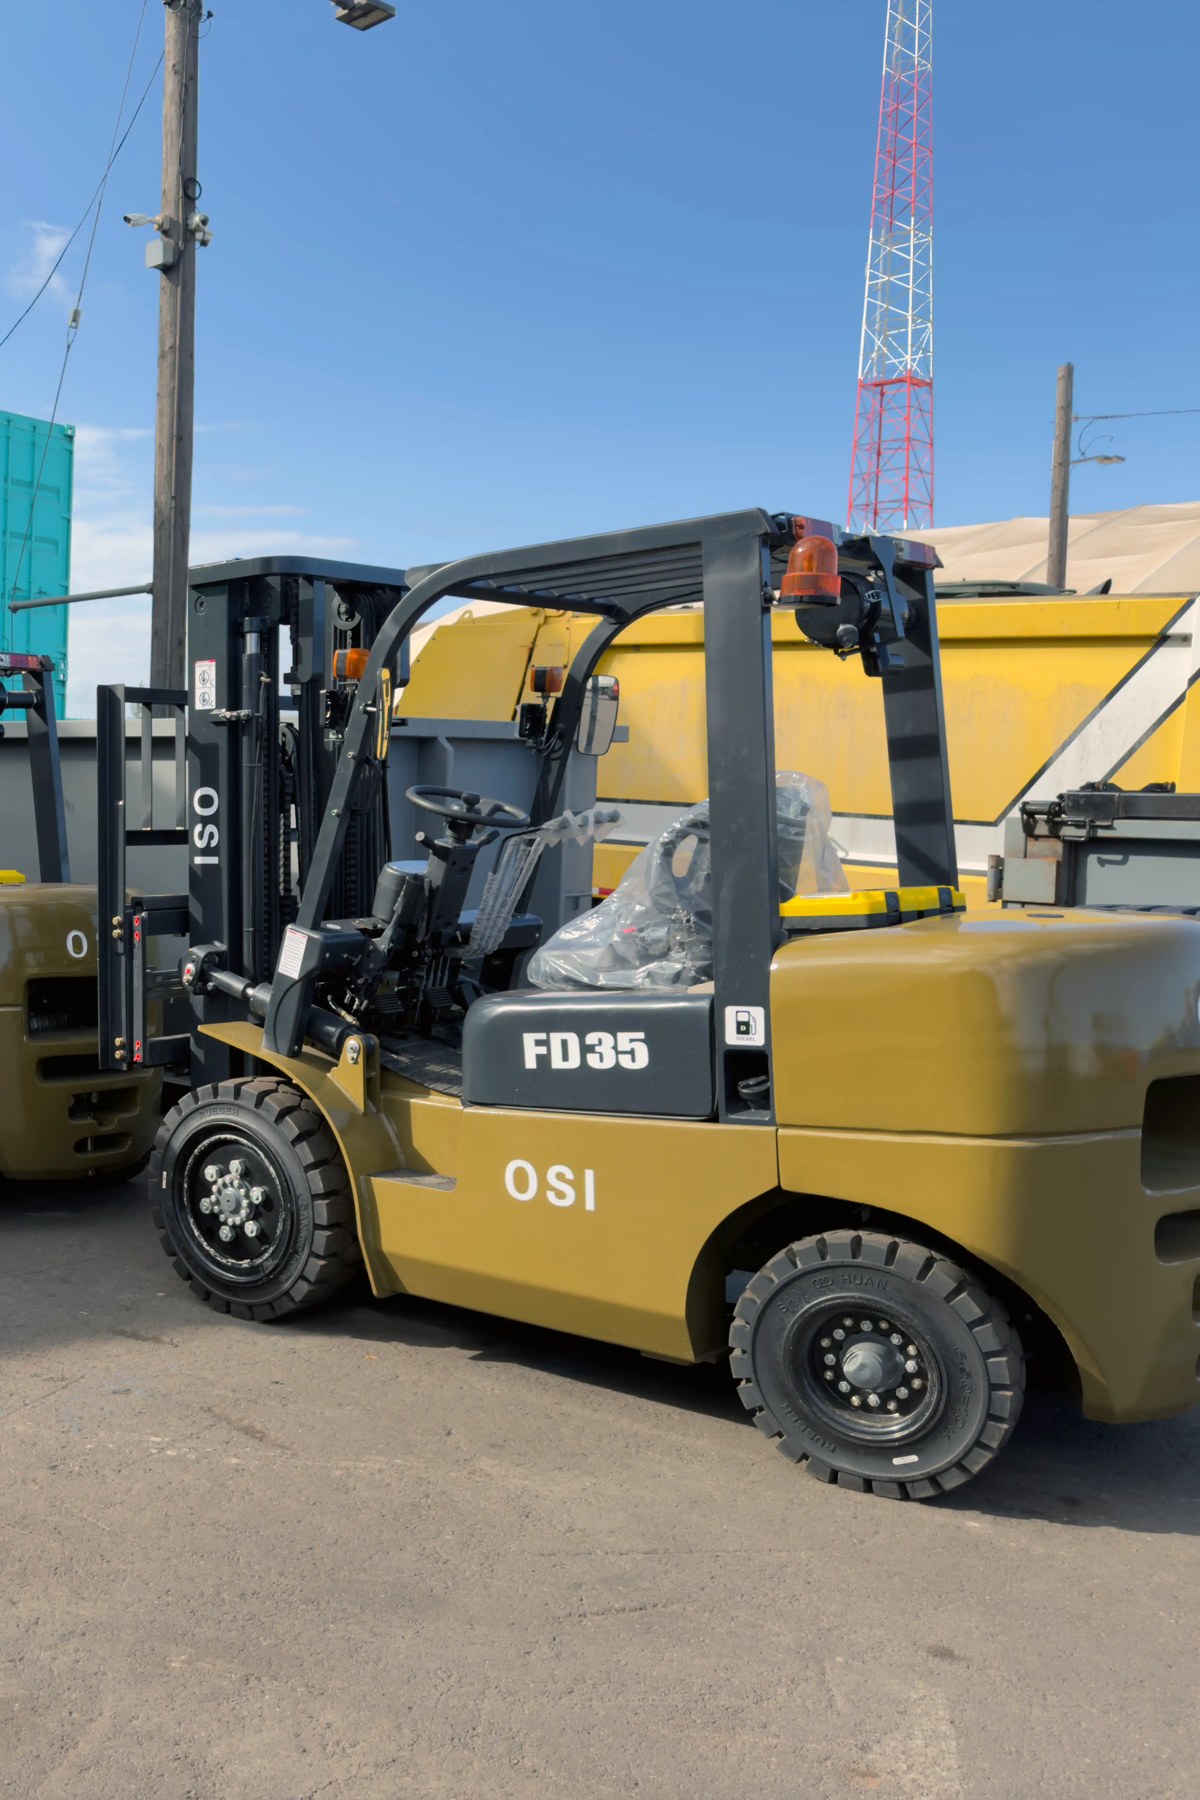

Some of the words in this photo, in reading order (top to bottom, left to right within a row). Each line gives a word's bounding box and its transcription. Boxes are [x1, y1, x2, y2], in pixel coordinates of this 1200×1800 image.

[522, 1031, 650, 1070] FD35
[200, 1107, 240, 1119] RUBBER
[504, 1159, 596, 1211] OSI
[841, 1273, 888, 1291] HUAN
